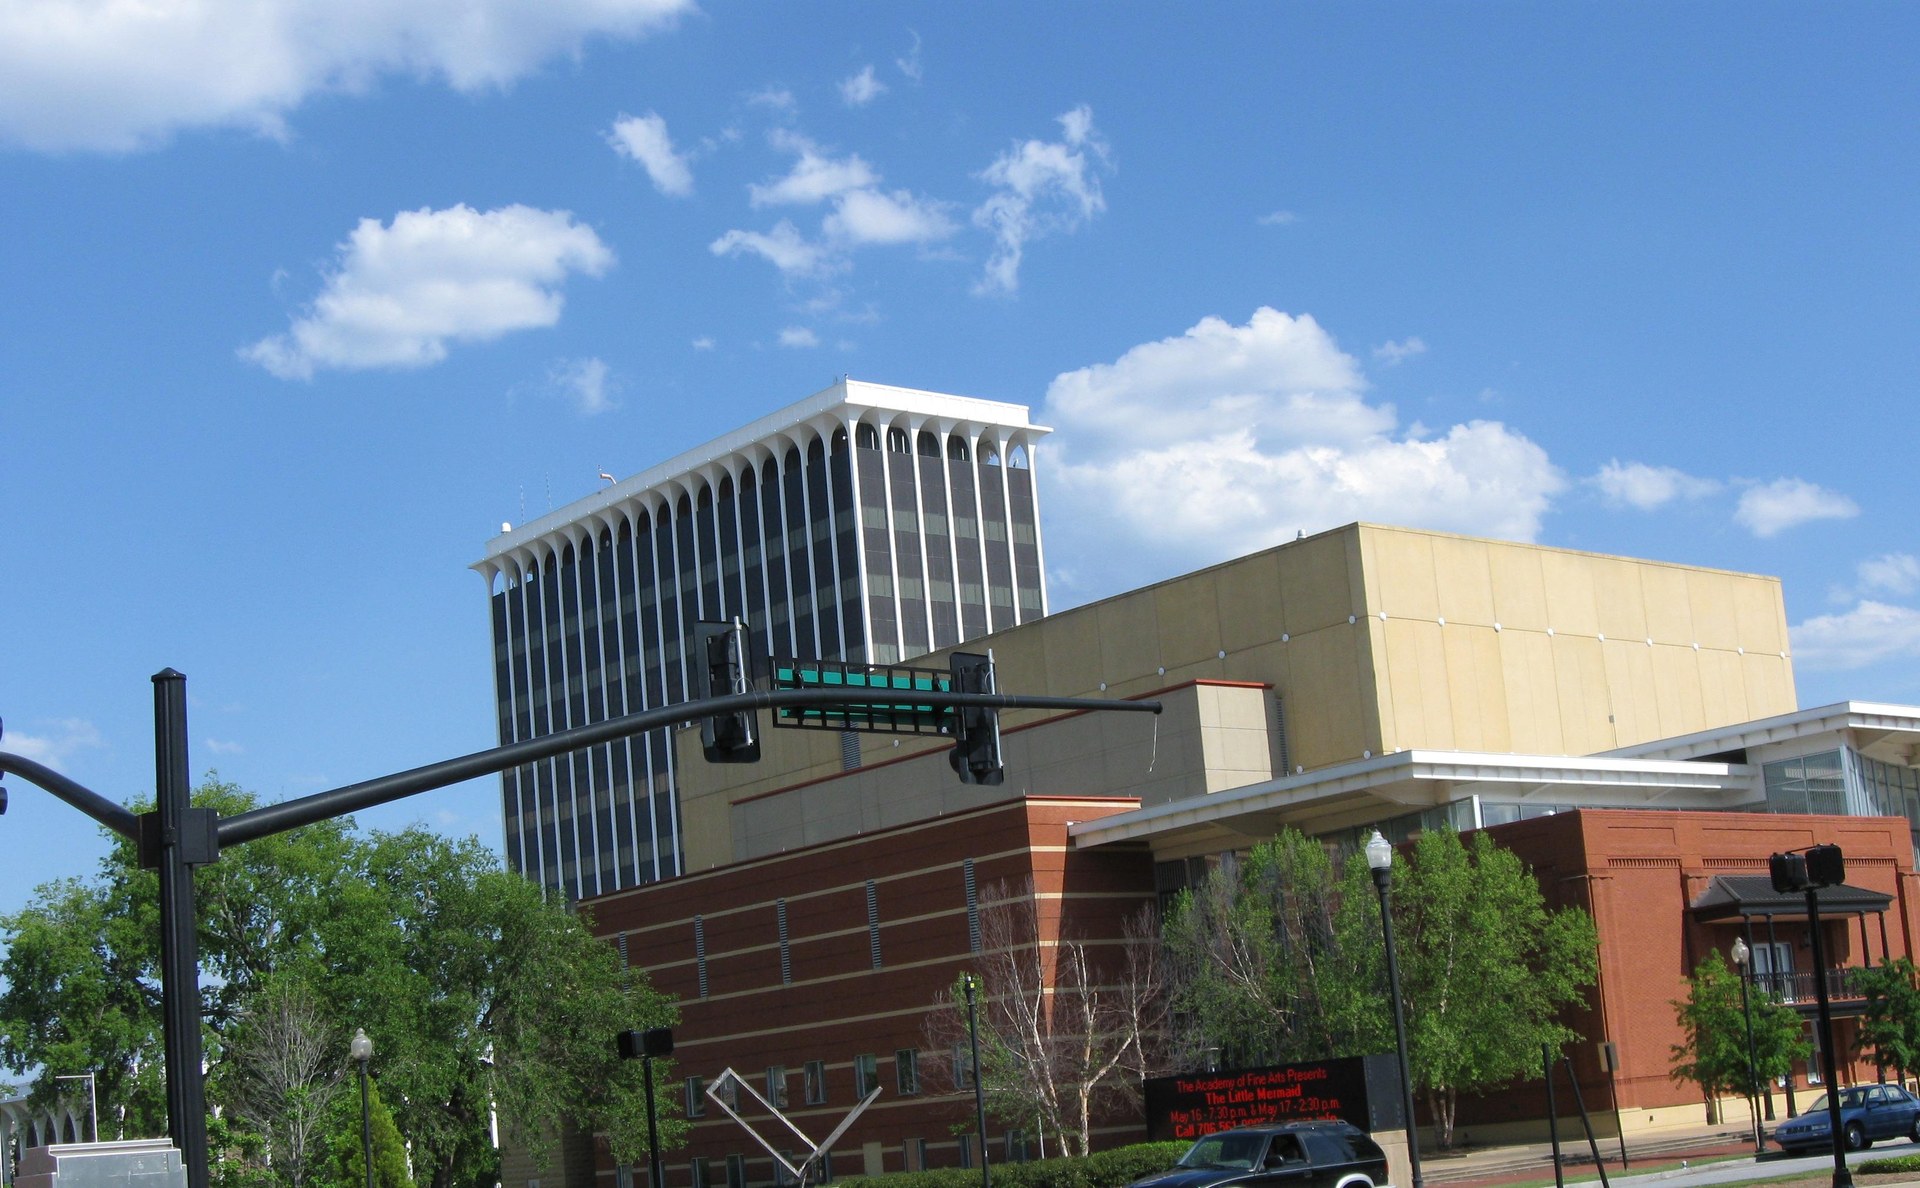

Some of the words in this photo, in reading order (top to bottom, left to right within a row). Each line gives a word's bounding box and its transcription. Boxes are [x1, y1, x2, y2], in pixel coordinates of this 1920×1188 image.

[1176, 1080, 1194, 1093] The
[1195, 1078, 1235, 1091] Academy
[1237, 1075, 1246, 1087] of
[1247, 1073, 1266, 1085] Fine
[1268, 1072, 1285, 1083] Arts
[1287, 1068, 1327, 1081] Presents
[1206, 1092, 1225, 1105] The
[1228, 1089, 1254, 1103] Little
[1257, 1084, 1302, 1100] Mermaid
[1170, 1110, 1189, 1124] May
[1192, 1108, 1203, 1121] 16
[1209, 1106, 1228, 1120] 7:30
[1258, 1102, 1277, 1117] May
[1280, 1100, 1291, 1113] 17
[1299, 1097, 1320, 1112] 2:30
[1175, 1123, 1194, 1137] Call
